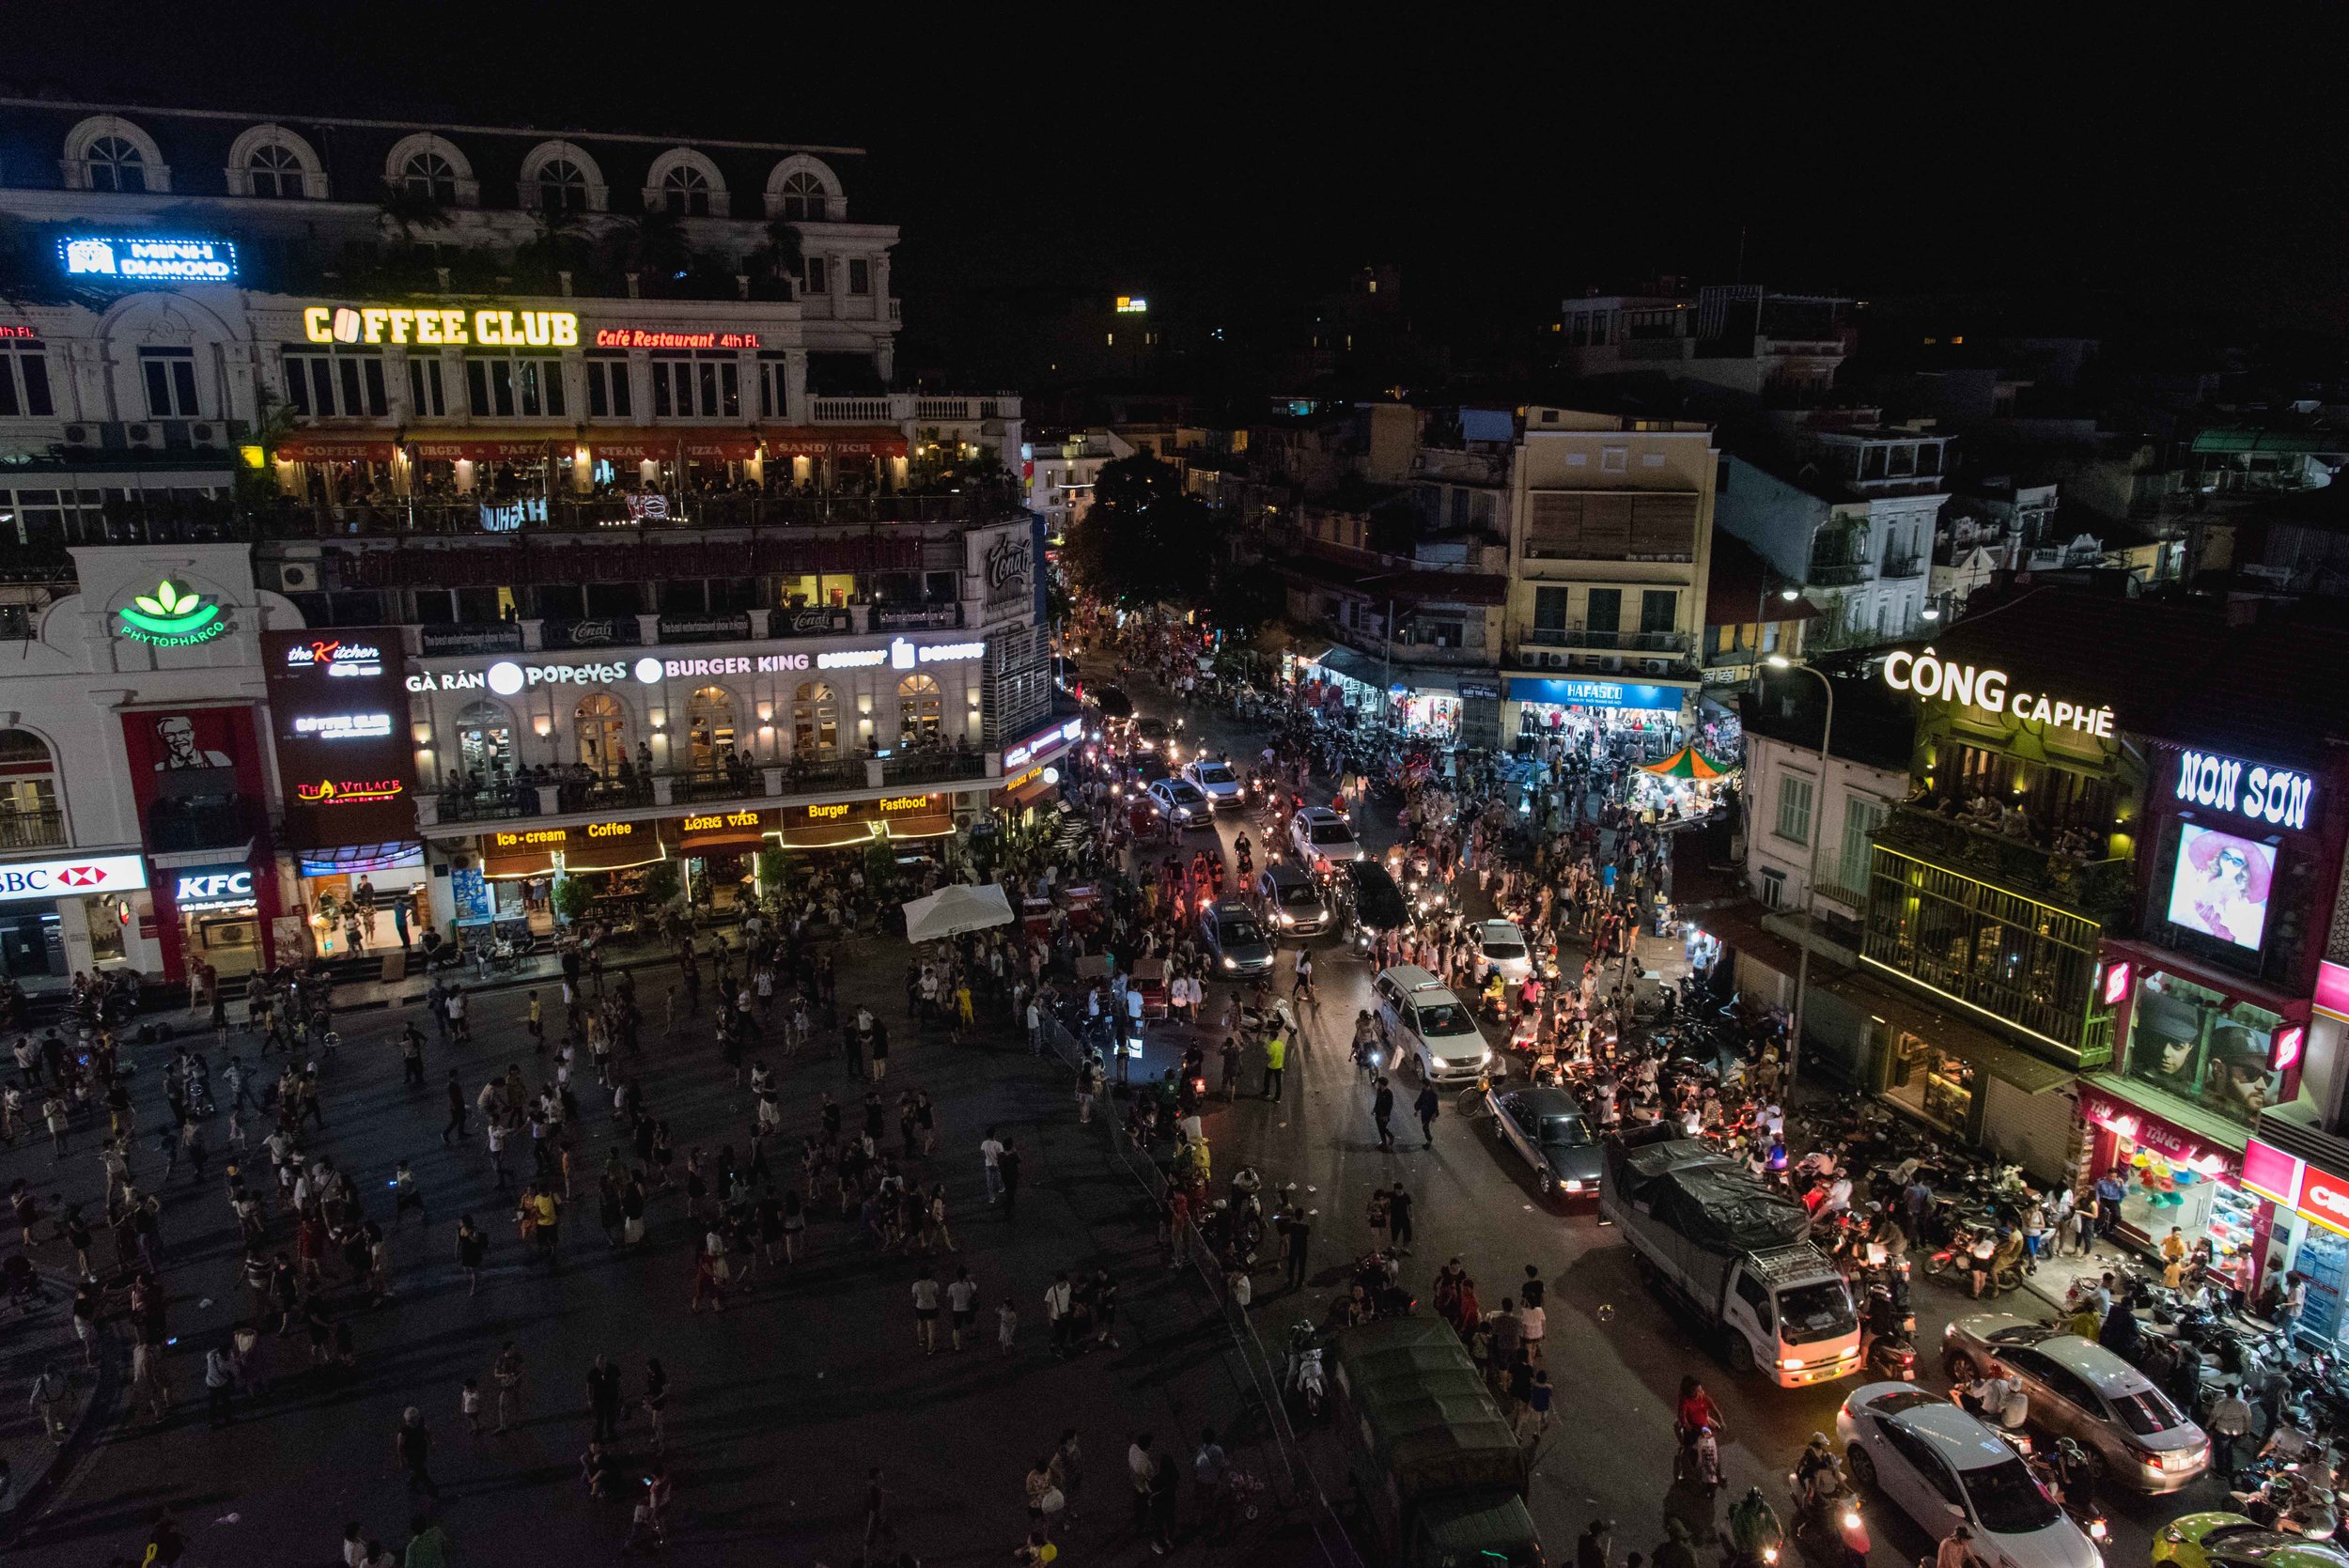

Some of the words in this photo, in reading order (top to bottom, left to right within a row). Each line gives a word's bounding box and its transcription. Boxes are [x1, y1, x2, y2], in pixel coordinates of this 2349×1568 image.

[131, 243, 214, 259] MINH
[121, 259, 230, 276] DIAMOND
[474, 310, 579, 346] CLUB
[597, 329, 630, 347] Café
[632, 330, 715, 348] Restaurant
[721, 334, 742, 348] 4th
[303, 446, 367, 456] COFFEE
[419, 445, 462, 456] URGER
[599, 446, 646, 456] STEAK
[120, 622, 225, 647] PHYTOPHARCO
[288, 646, 314, 661] the
[312, 640, 380, 662] Kitchen
[665, 657, 752, 677] BURGER
[757, 654, 809, 673] KING
[405, 671, 437, 692] GÀ
[442, 670, 485, 691] RÁN
[1884, 646, 2008, 712] CỘNG
[1567, 684, 1623, 700] HAFASCO
[298, 780, 337, 800] THAI
[809, 803, 849, 818] Burger
[879, 796, 926, 811] Fastfood
[588, 822, 632, 837] Coffee
[684, 816, 723, 831] LONG
[177, 872, 252, 899] KFC
